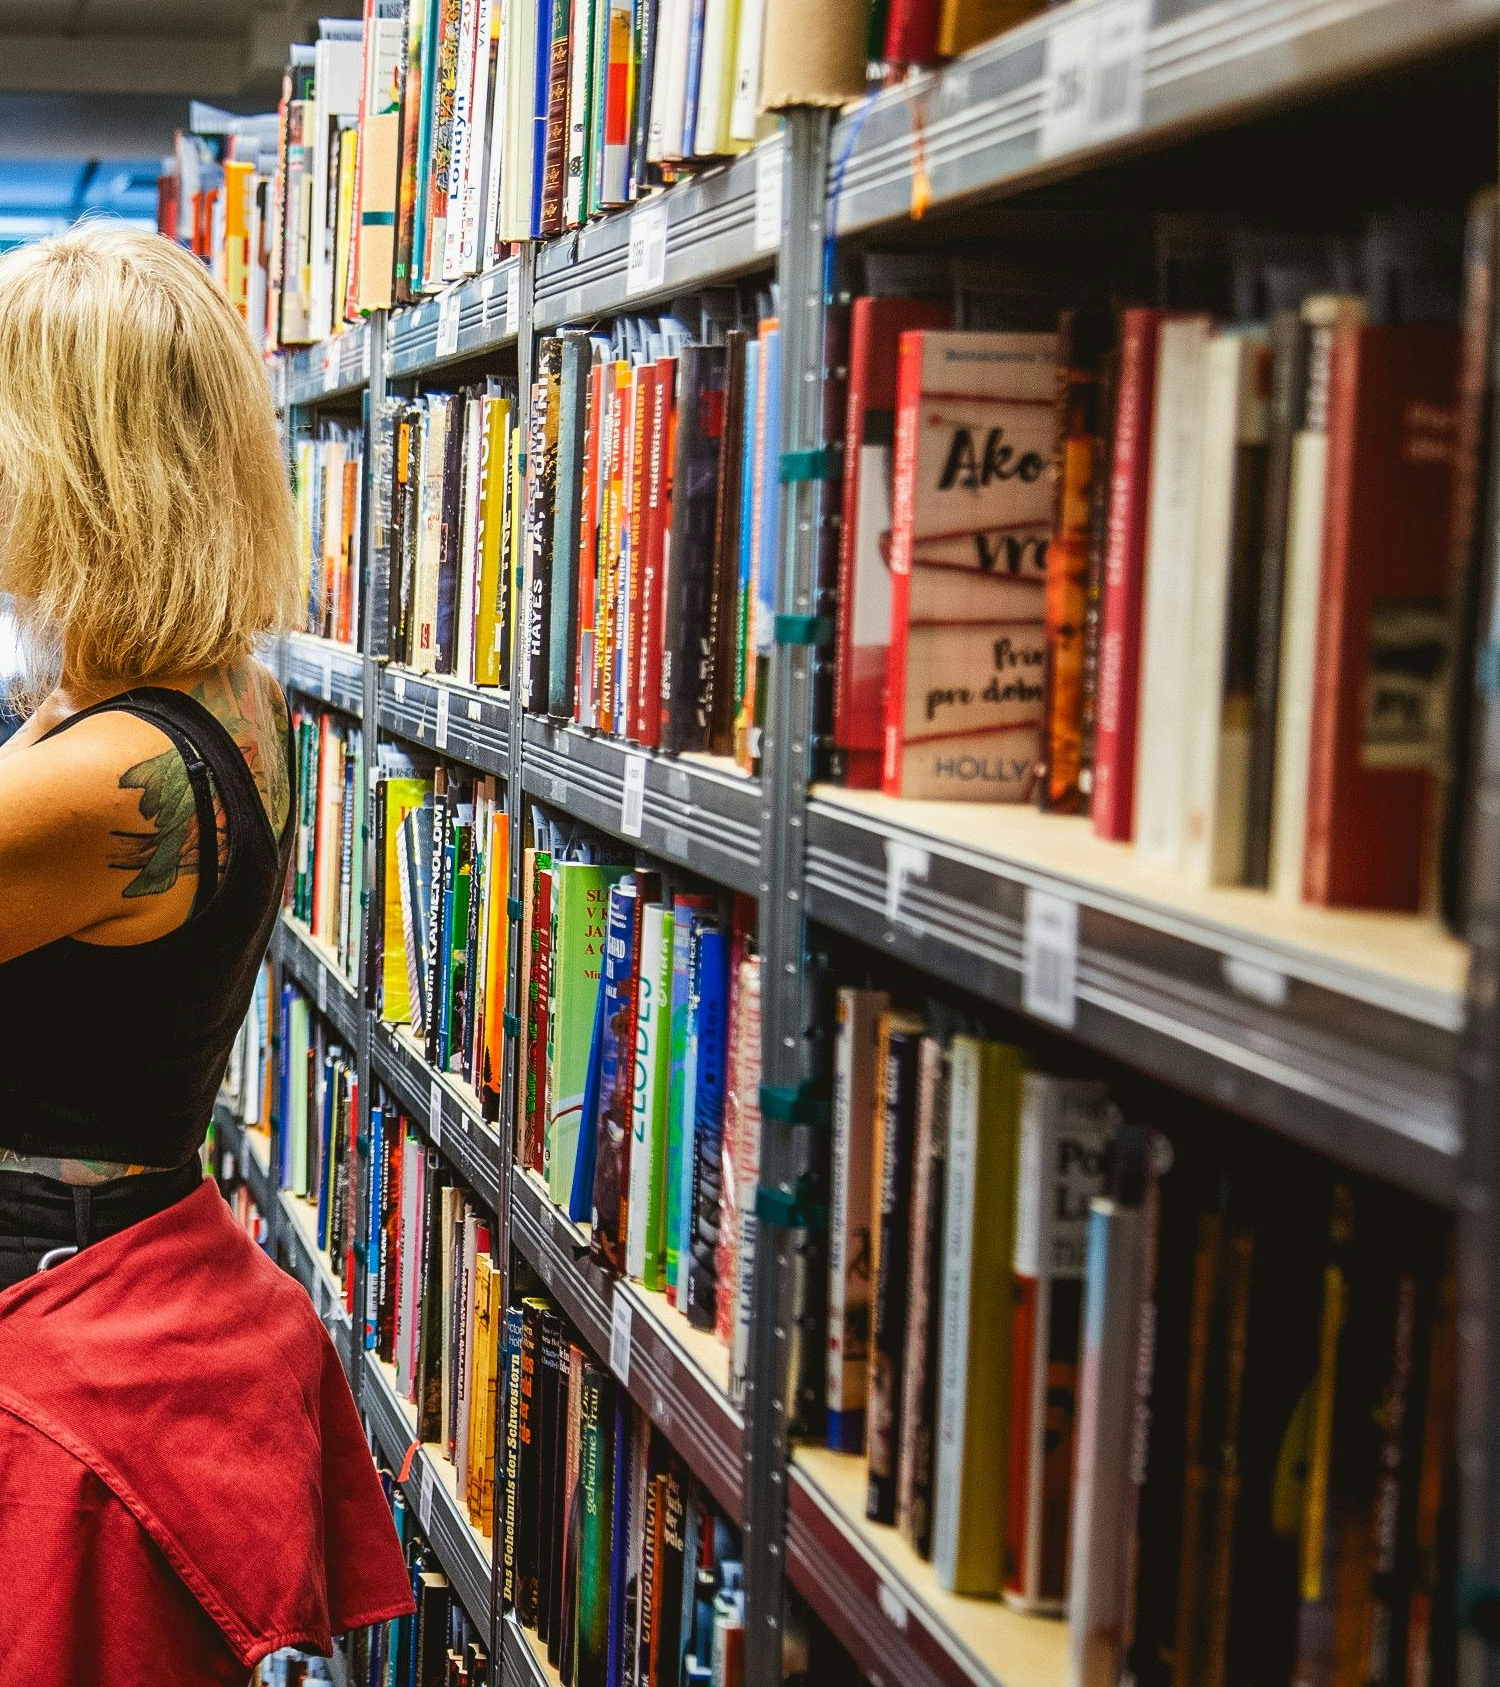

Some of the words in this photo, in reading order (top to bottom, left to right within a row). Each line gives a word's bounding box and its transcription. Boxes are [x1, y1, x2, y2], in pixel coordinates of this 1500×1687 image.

[477, 0, 487, 47] VAN
[449, 95, 467, 199] Londyn
[612, 398, 620, 472] CITADELA
[634, 384, 644, 475] LEONARDA
[937, 427, 1046, 490] Ako
[631, 480, 640, 545] MISTRA
[531, 578, 542, 655] HAYES
[605, 618, 612, 636] DE
[602, 645, 612, 712] ANTOINE
[934, 756, 1030, 781] HOLLY
[428, 804, 443, 965] KAMENOLOM
[587, 890, 609, 902] SL
[587, 908, 596, 918] V
[689, 936, 697, 964] Holt
[506, 1353, 520, 1449] Schwestern
[581, 1385, 589, 1419] Die
[587, 1386, 599, 1431] Frau
[506, 1450, 516, 1478] der
[583, 1435, 600, 1515] geheime
[503, 1480, 516, 1566] Geheimnis
[503, 1568, 512, 1601] Das
